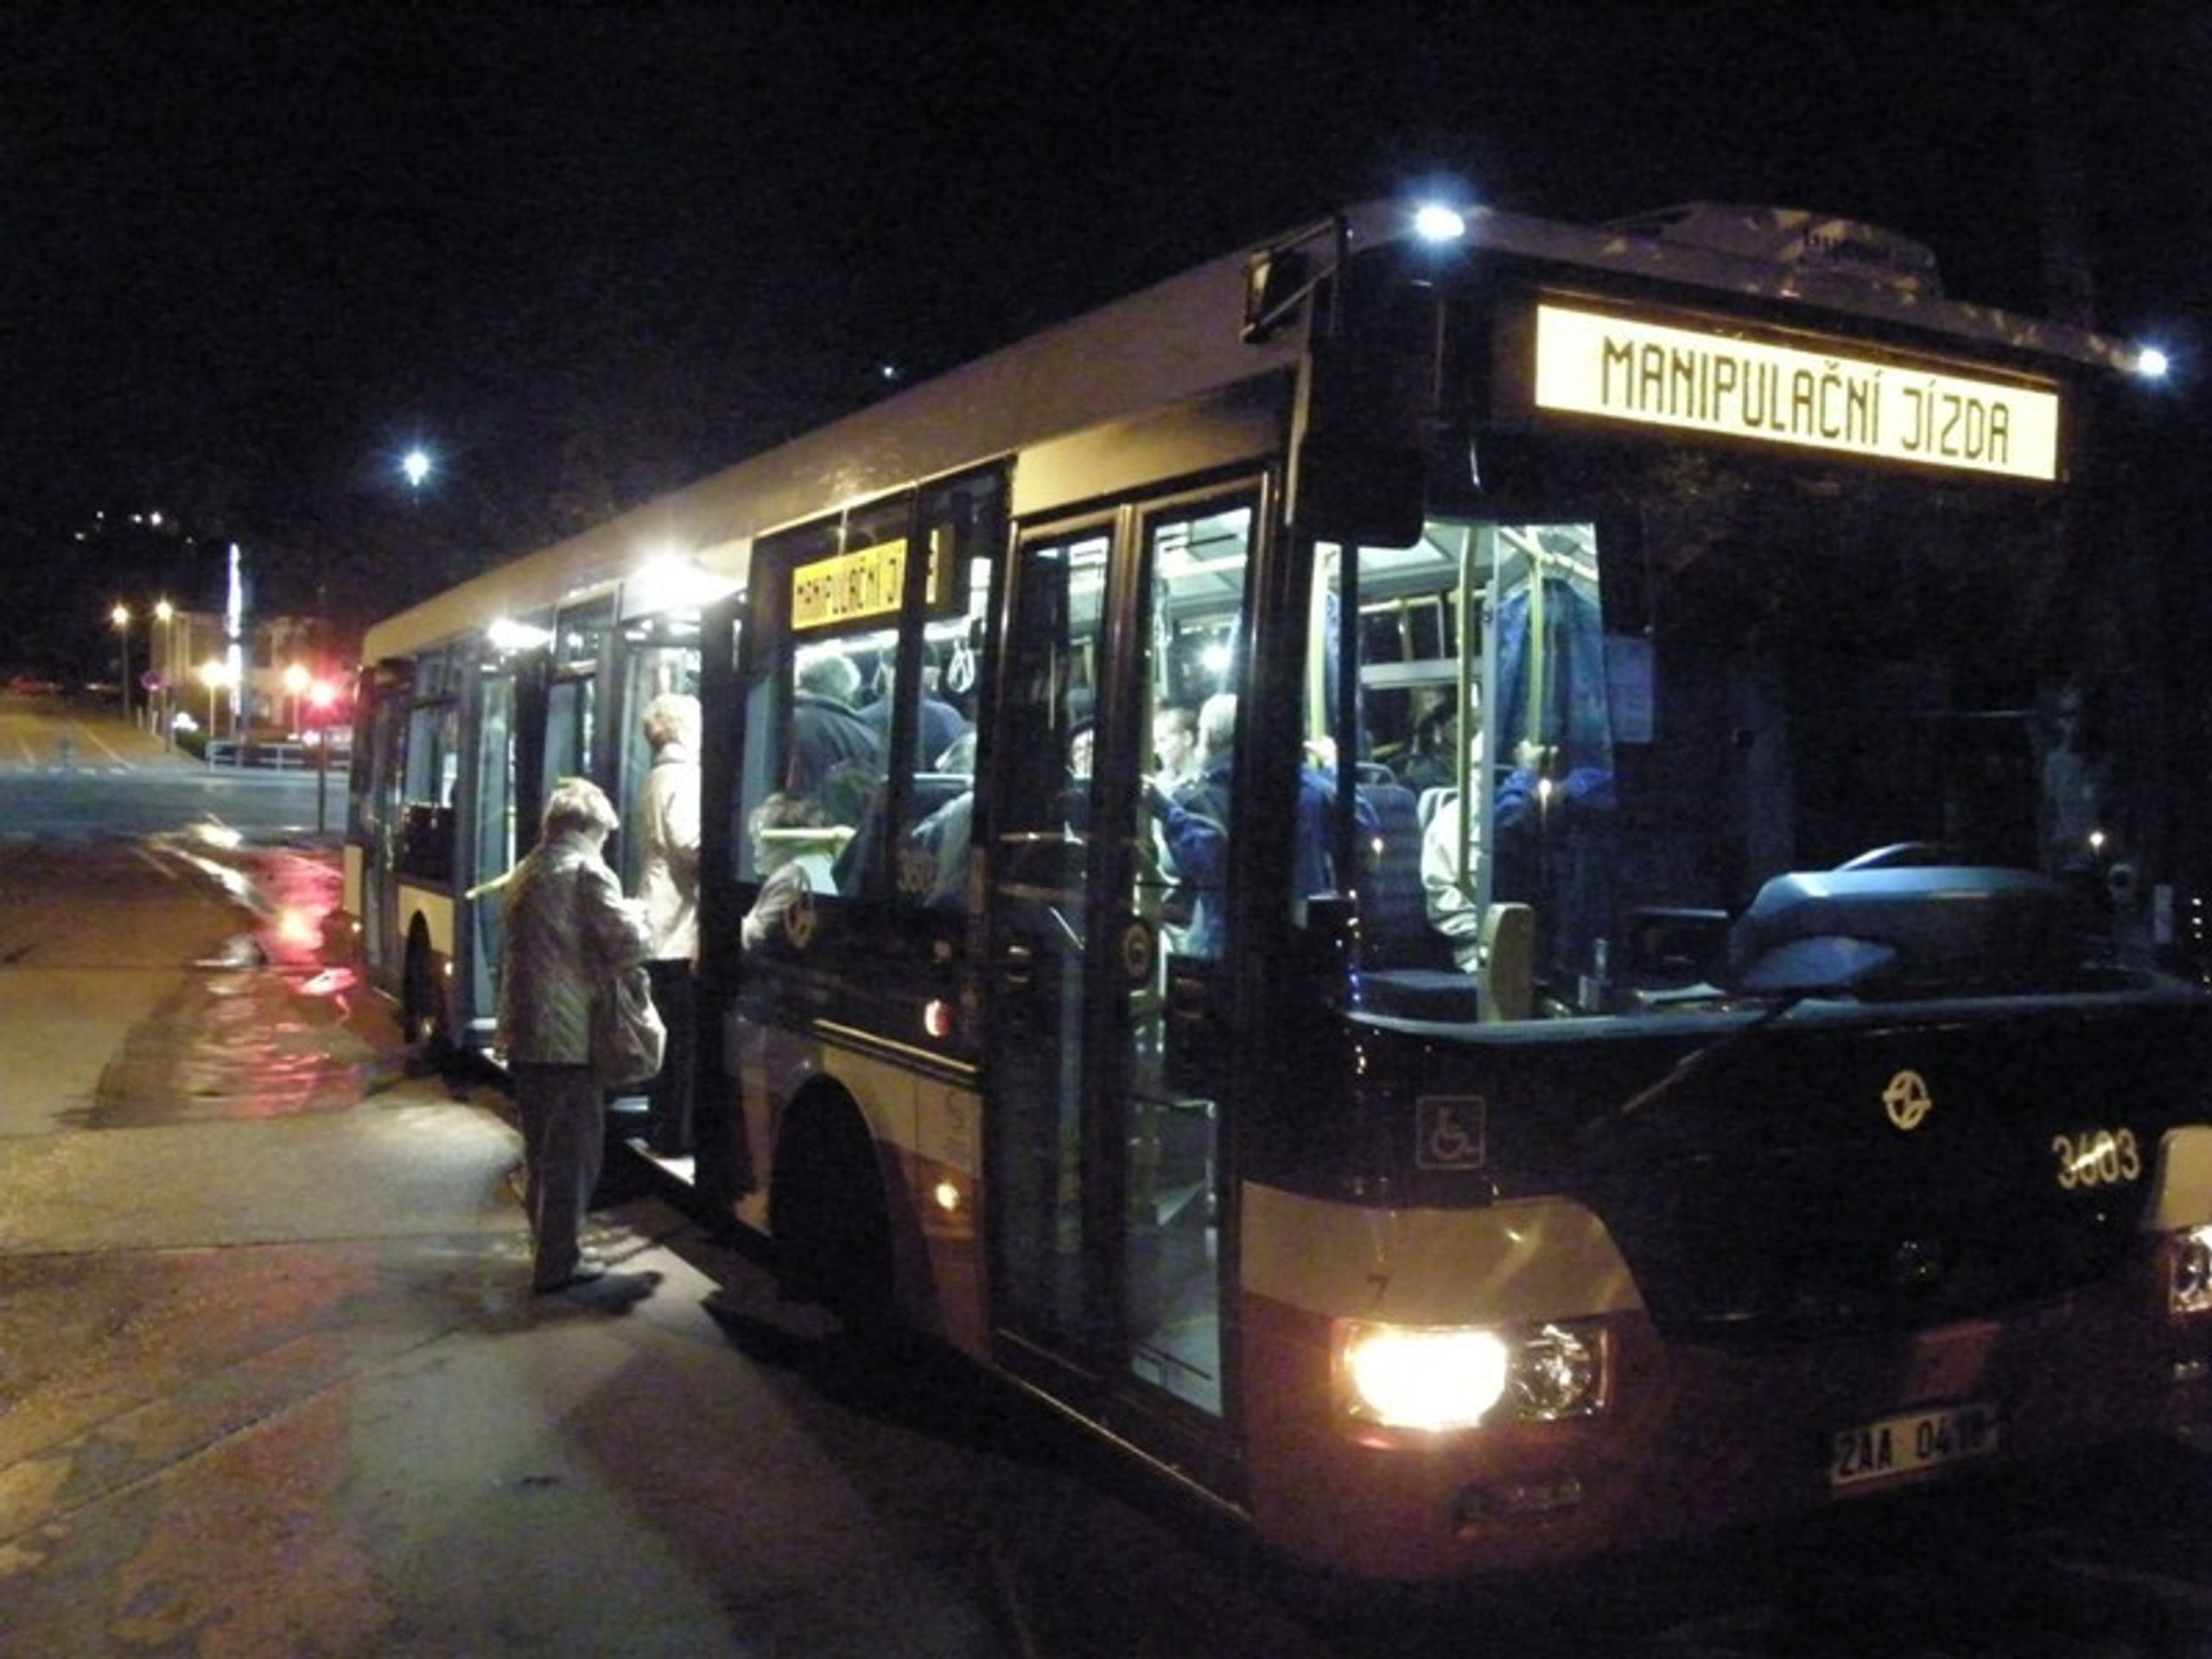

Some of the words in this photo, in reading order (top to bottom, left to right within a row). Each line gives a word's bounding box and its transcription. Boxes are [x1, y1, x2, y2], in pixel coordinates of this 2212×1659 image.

[1601, 334, 1884, 447] MANIPULAČNÍ
[1901, 378, 2011, 465] JÍZDA
[2052, 1128, 2141, 1191] 3603
